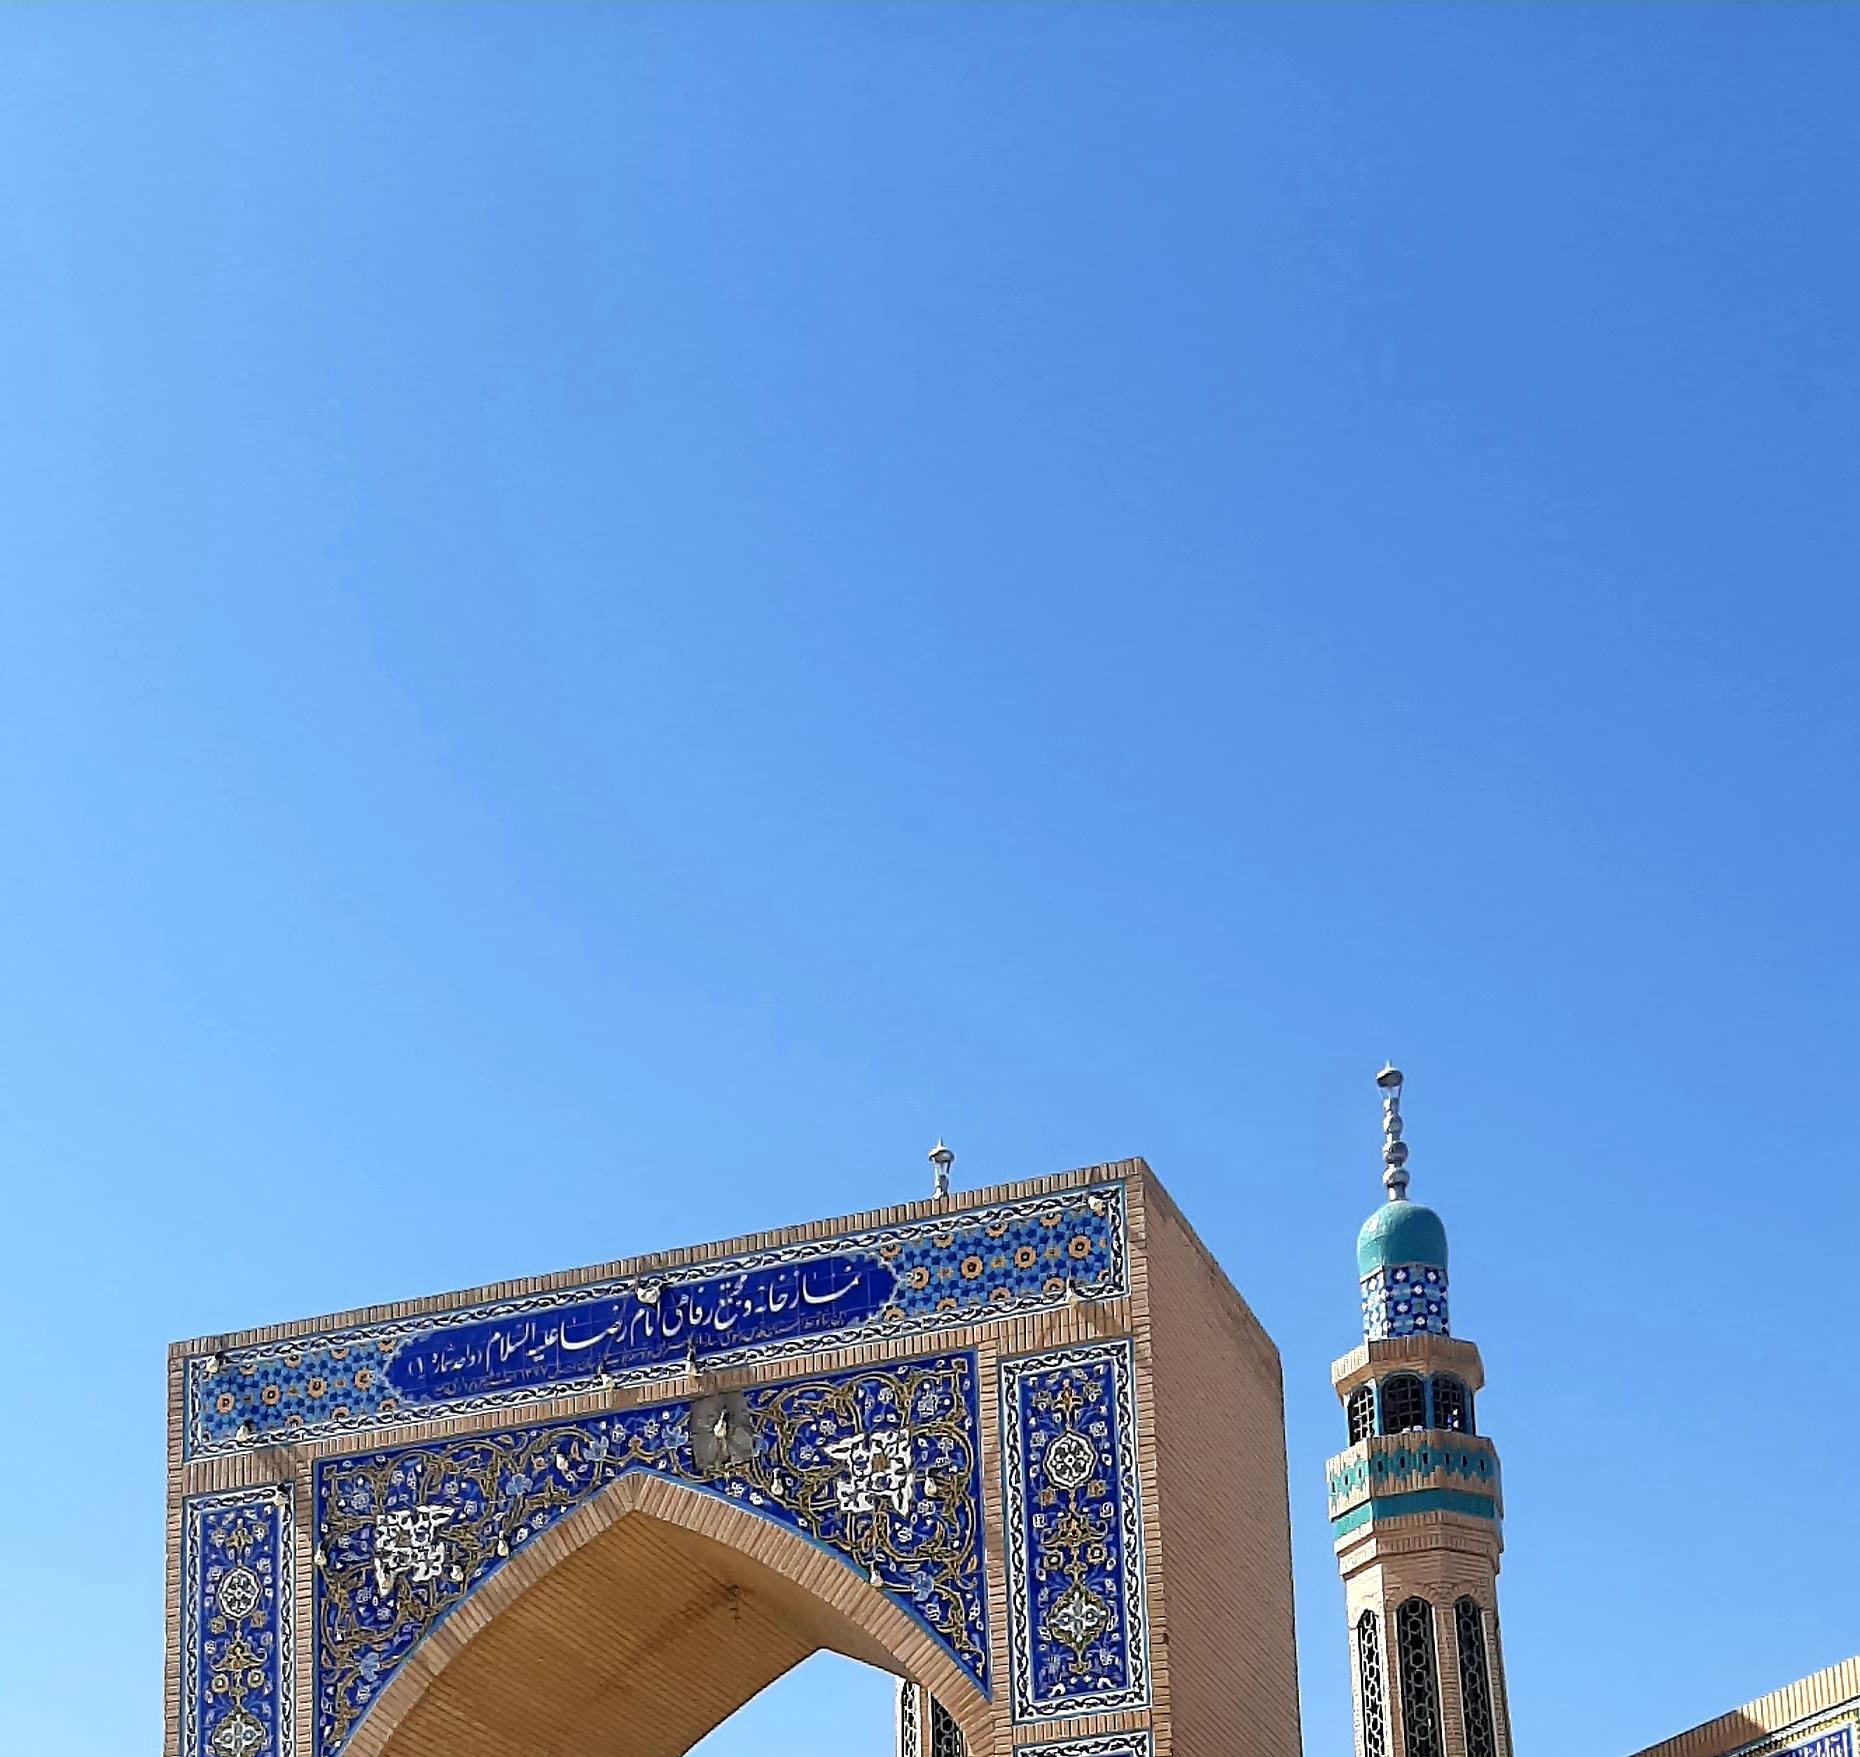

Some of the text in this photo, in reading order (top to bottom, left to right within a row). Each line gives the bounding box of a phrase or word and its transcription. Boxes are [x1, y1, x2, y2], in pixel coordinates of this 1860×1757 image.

[561, 1304, 628, 1351] رضا
[631, 1296, 661, 1346] امام
[742, 1299, 752, 1318] و
